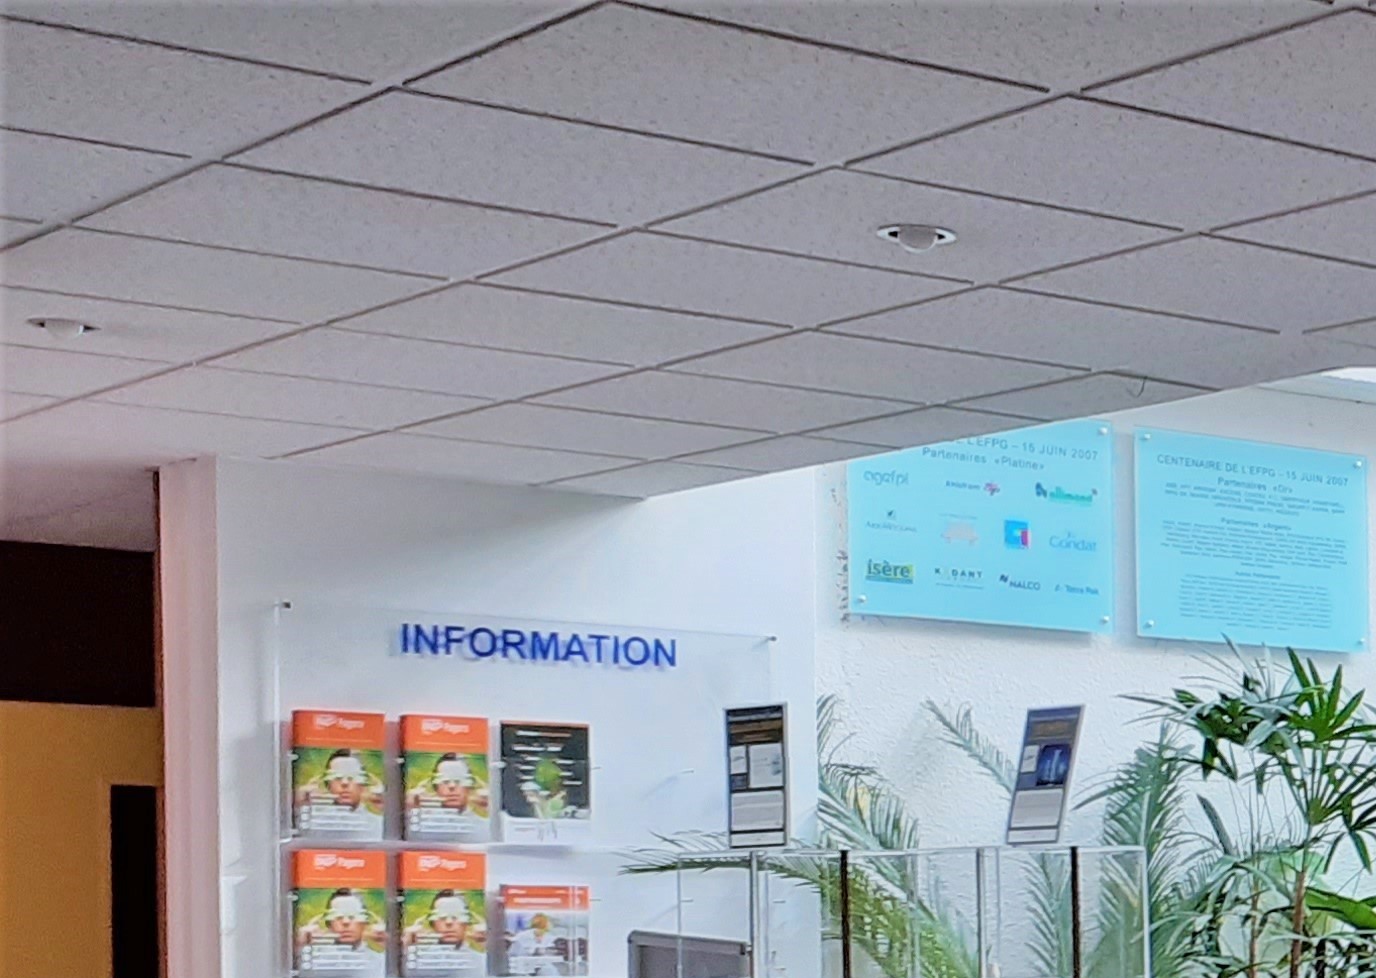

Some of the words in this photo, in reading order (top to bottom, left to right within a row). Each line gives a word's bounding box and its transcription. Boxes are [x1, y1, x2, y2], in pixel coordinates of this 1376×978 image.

[921, 446, 987, 465] Partenaires
[1039, 444, 1067, 457] JUIN
[1071, 448, 1099, 461] 2007
[1157, 454, 1221, 471] CENTENAIRE
[1225, 463, 1238, 473] DE
[1241, 465, 1275, 478] L'EFPG
[1286, 471, 1297, 480] 15
[1300, 473, 1323, 484] JUIN
[1326, 475, 1349, 487] 2007
[1217, 476, 1267, 492] Partenaires
[867, 559, 911, 578] isère
[934, 567, 983, 579] KDANT
[1009, 580, 1041, 591] NALCO
[400, 623, 679, 668] INFORMATION
